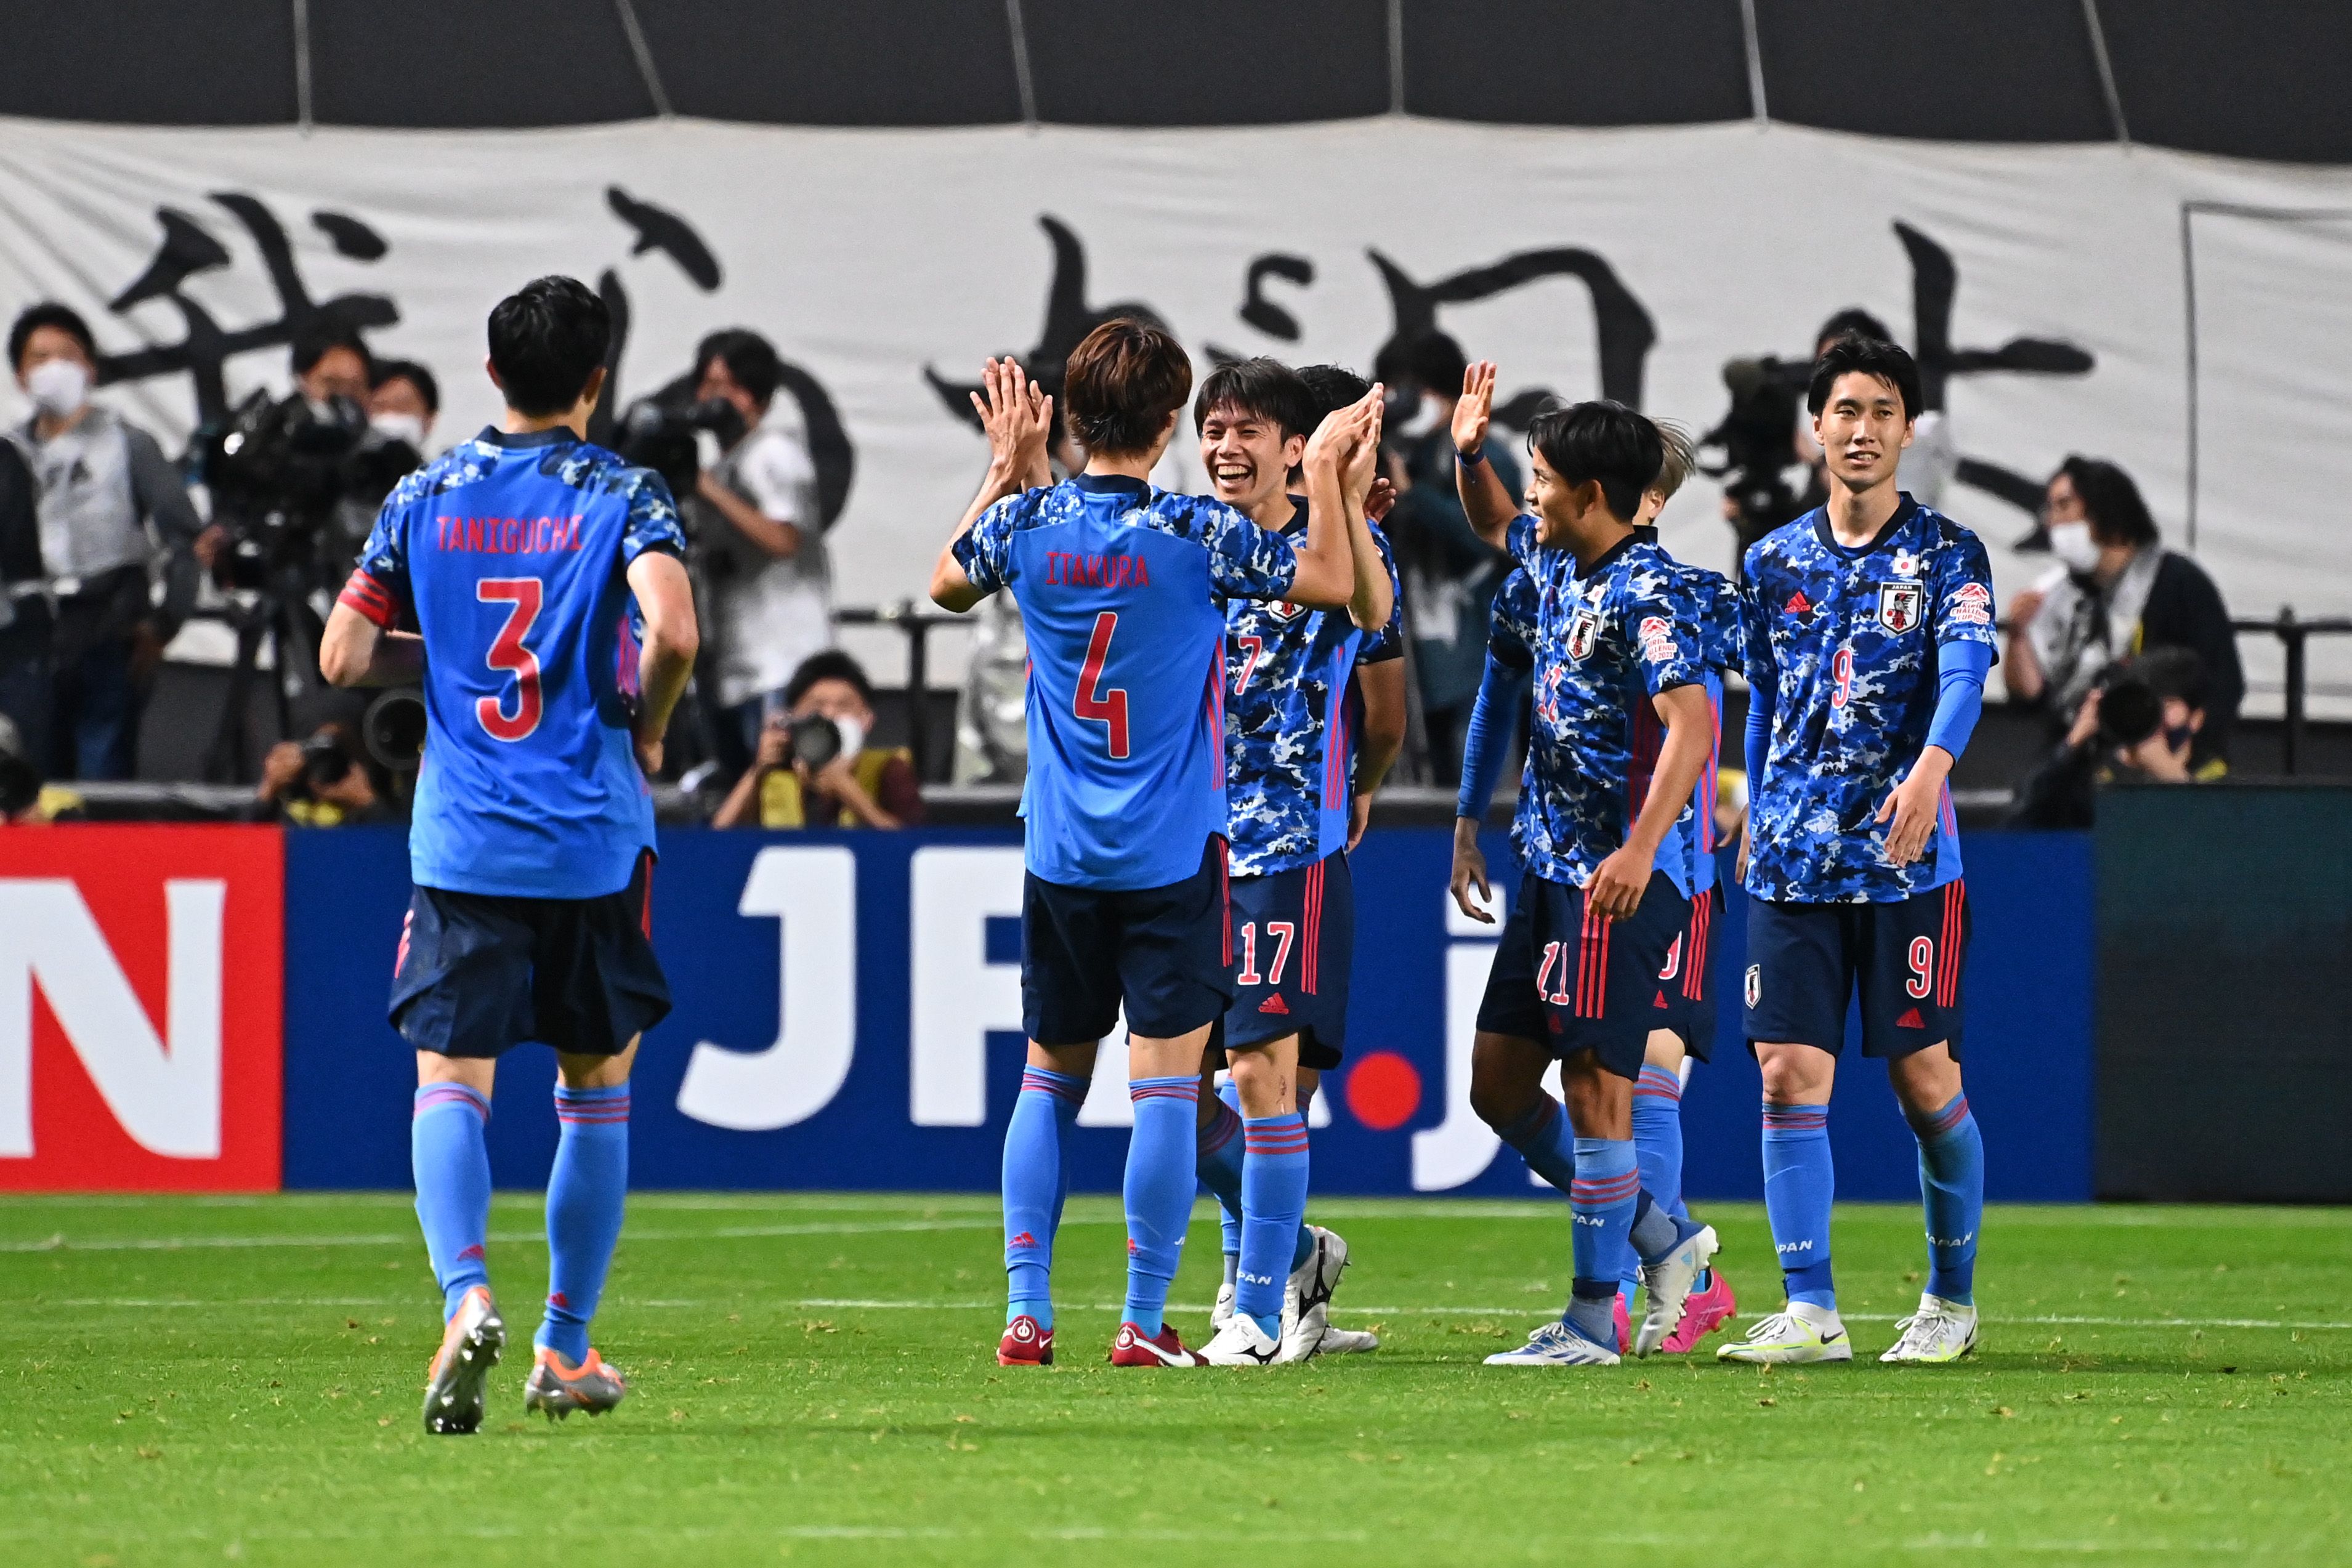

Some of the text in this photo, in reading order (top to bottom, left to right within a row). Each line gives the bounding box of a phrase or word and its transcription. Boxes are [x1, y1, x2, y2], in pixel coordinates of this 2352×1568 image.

[436, 514, 585, 554] TANIGUCHI
[1045, 551, 1150, 588] ITAKURA
[476, 577, 543, 742] 3
[1073, 612, 1130, 759] 4
[1831, 647, 1853, 709] 9
[1238, 921, 1294, 985] 17
[1905, 936, 1933, 999] 9
